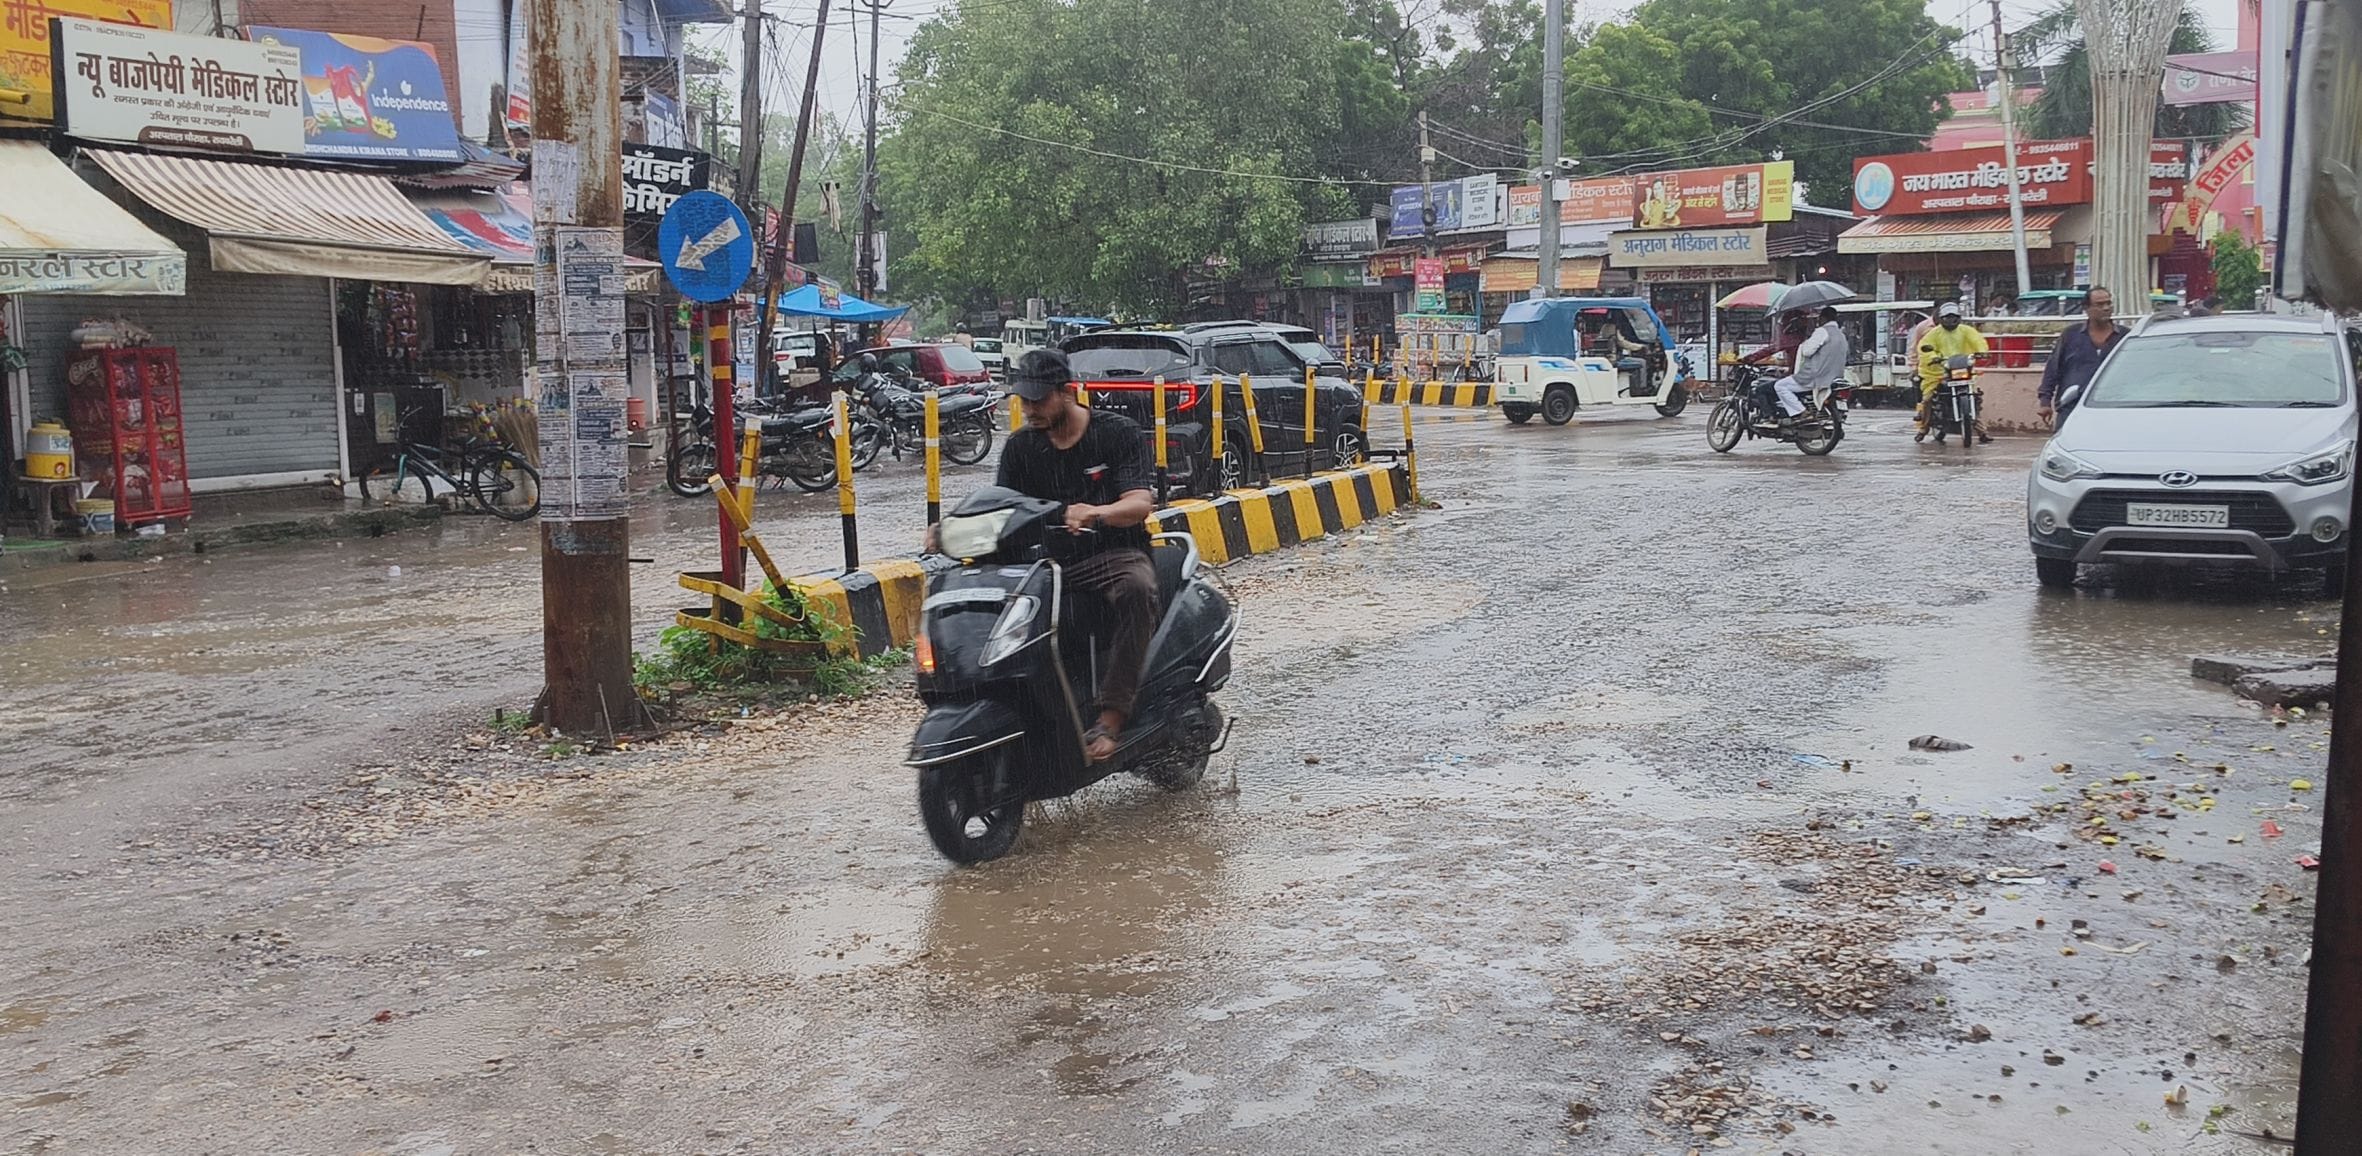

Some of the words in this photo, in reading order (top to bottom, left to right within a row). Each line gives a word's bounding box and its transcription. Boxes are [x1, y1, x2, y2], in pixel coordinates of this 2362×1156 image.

[76, 52, 106, 98] न्यू
[107, 51, 185, 96] बाजपेयी
[190, 57, 259, 103] मेडिकल
[264, 68, 299, 107] स्टोर
[113, 94, 139, 105] समस्त
[141, 97, 162, 107] प्रकार
[164, 97, 175, 108] की
[371, 88, 449, 112] Independence
[150, 111, 170, 121] उचित
[190, 115, 201, 125] पर
[621, 150, 695, 186] मॉडर्न
[1902, 173, 1931, 193] जय
[1930, 169, 1969, 190] भारत
[2031, 156, 2071, 184] स्टोर
[2195, 140, 2255, 194] जिला
[622, 180, 683, 215] केमि
[1570, 181, 1606, 199] डिकल
[1921, 197, 1965, 209] अस्पताल
[1623, 236, 1667, 258] अनुराग
[1671, 232, 1718, 252] मेडिकल
[1723, 230, 1751, 251] स्टोर
[0, 259, 73, 279] नरल
[2136, 507, 2226, 524] UP32HB5572
